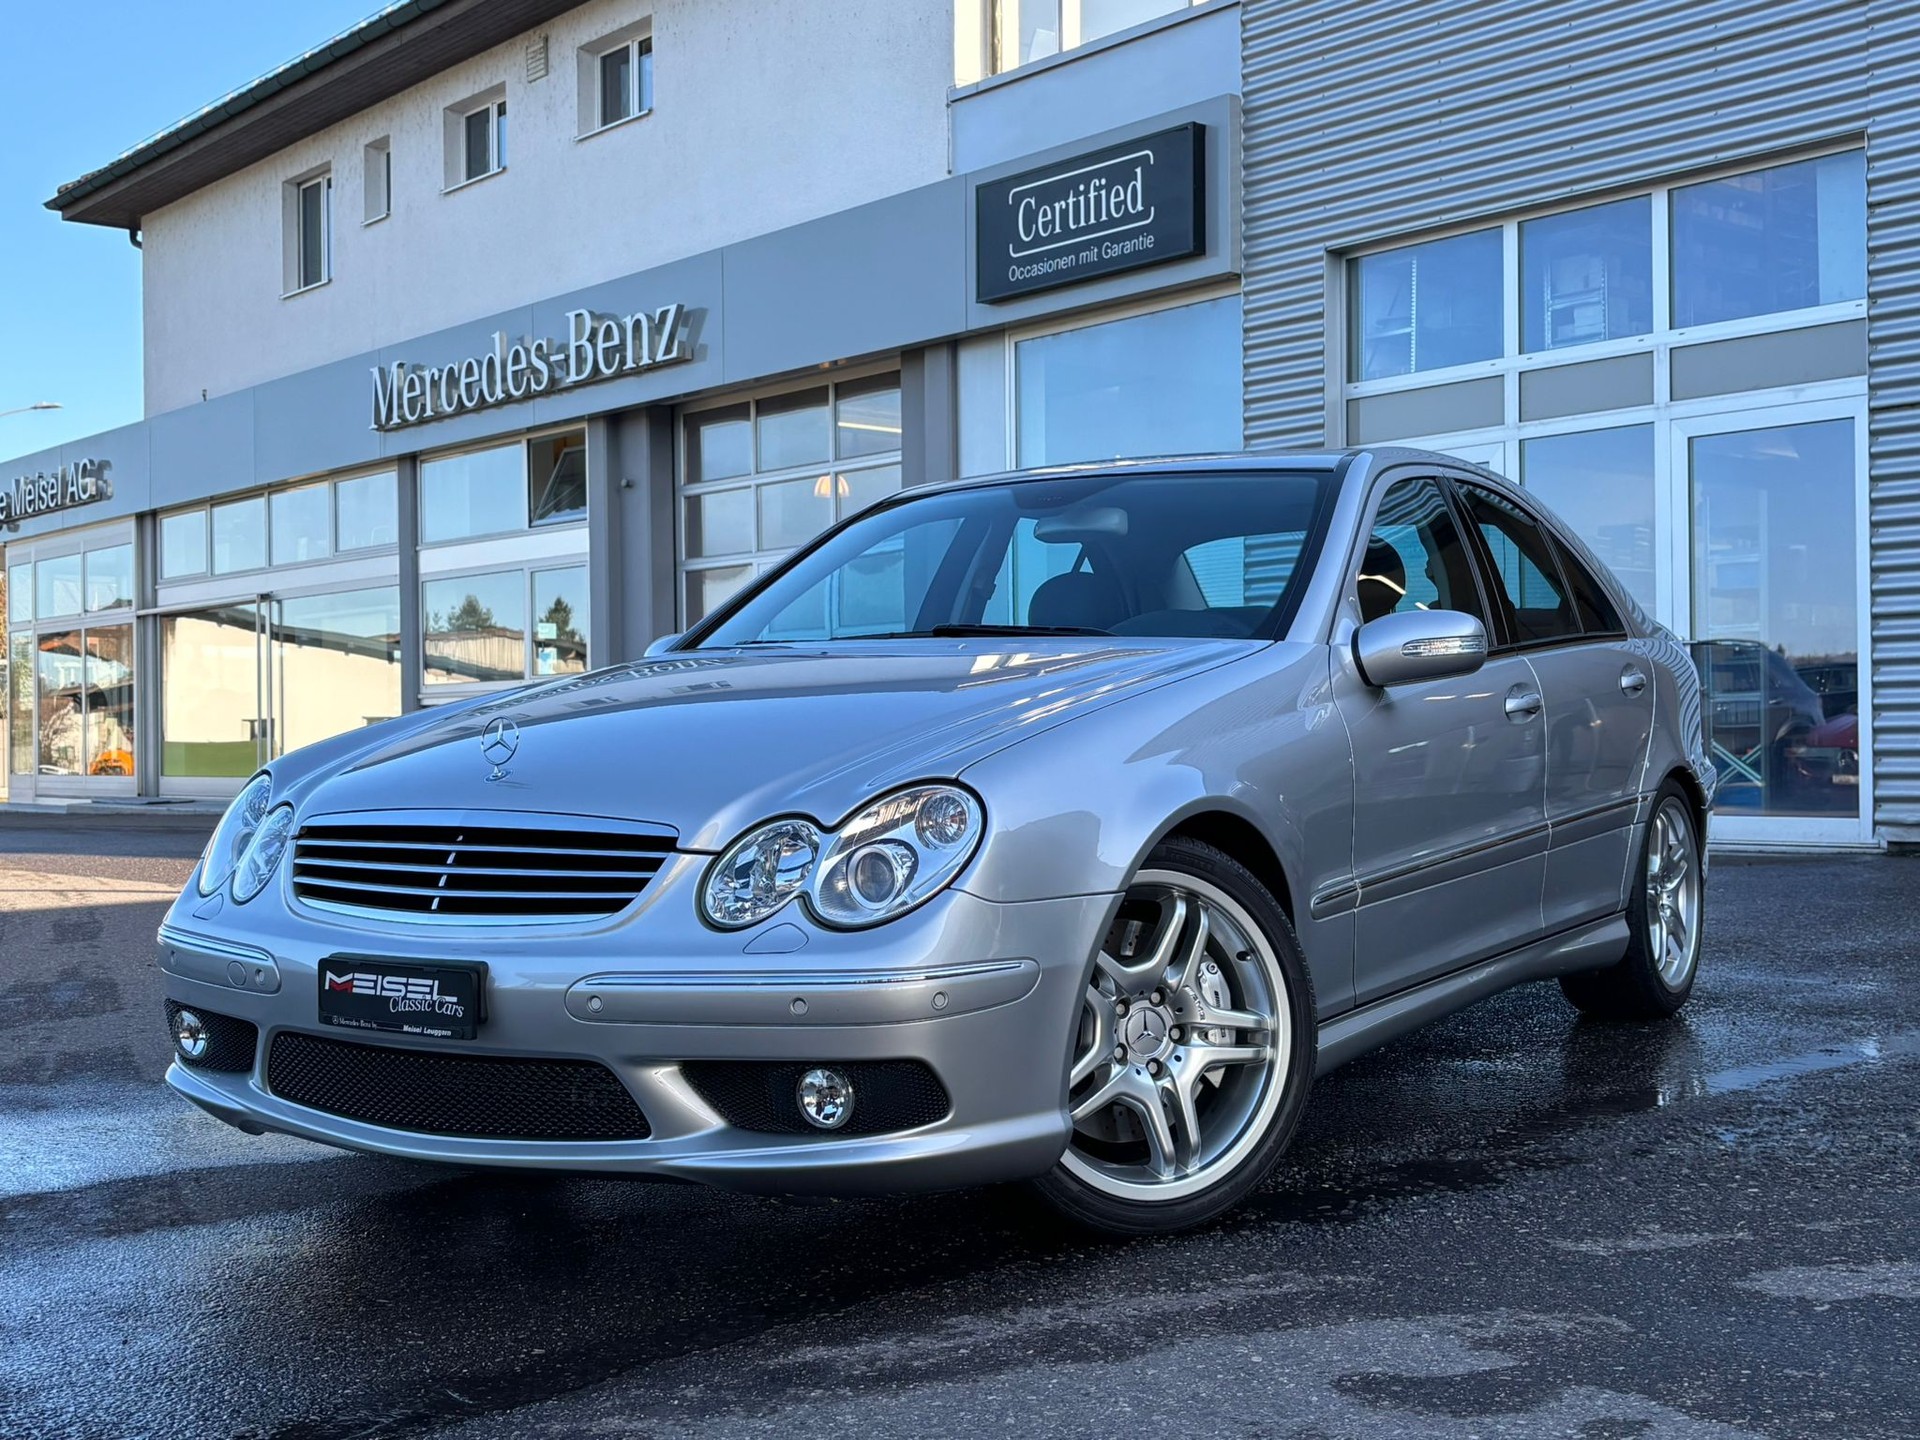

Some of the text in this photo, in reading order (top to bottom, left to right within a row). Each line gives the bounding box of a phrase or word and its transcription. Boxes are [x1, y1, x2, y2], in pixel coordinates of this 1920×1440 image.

[1017, 166, 1145, 243] Certified
[1008, 232, 1155, 282] Occasionen mit Garantie
[369, 304, 686, 430] Mercedes-Benz
[10, 465, 61, 517] Meisel
[66, 458, 92, 504] AG
[324, 970, 458, 1003] MEISEL
[389, 995, 465, 1018] Classic Cars
[403, 1025, 422, 1033] Meisel
